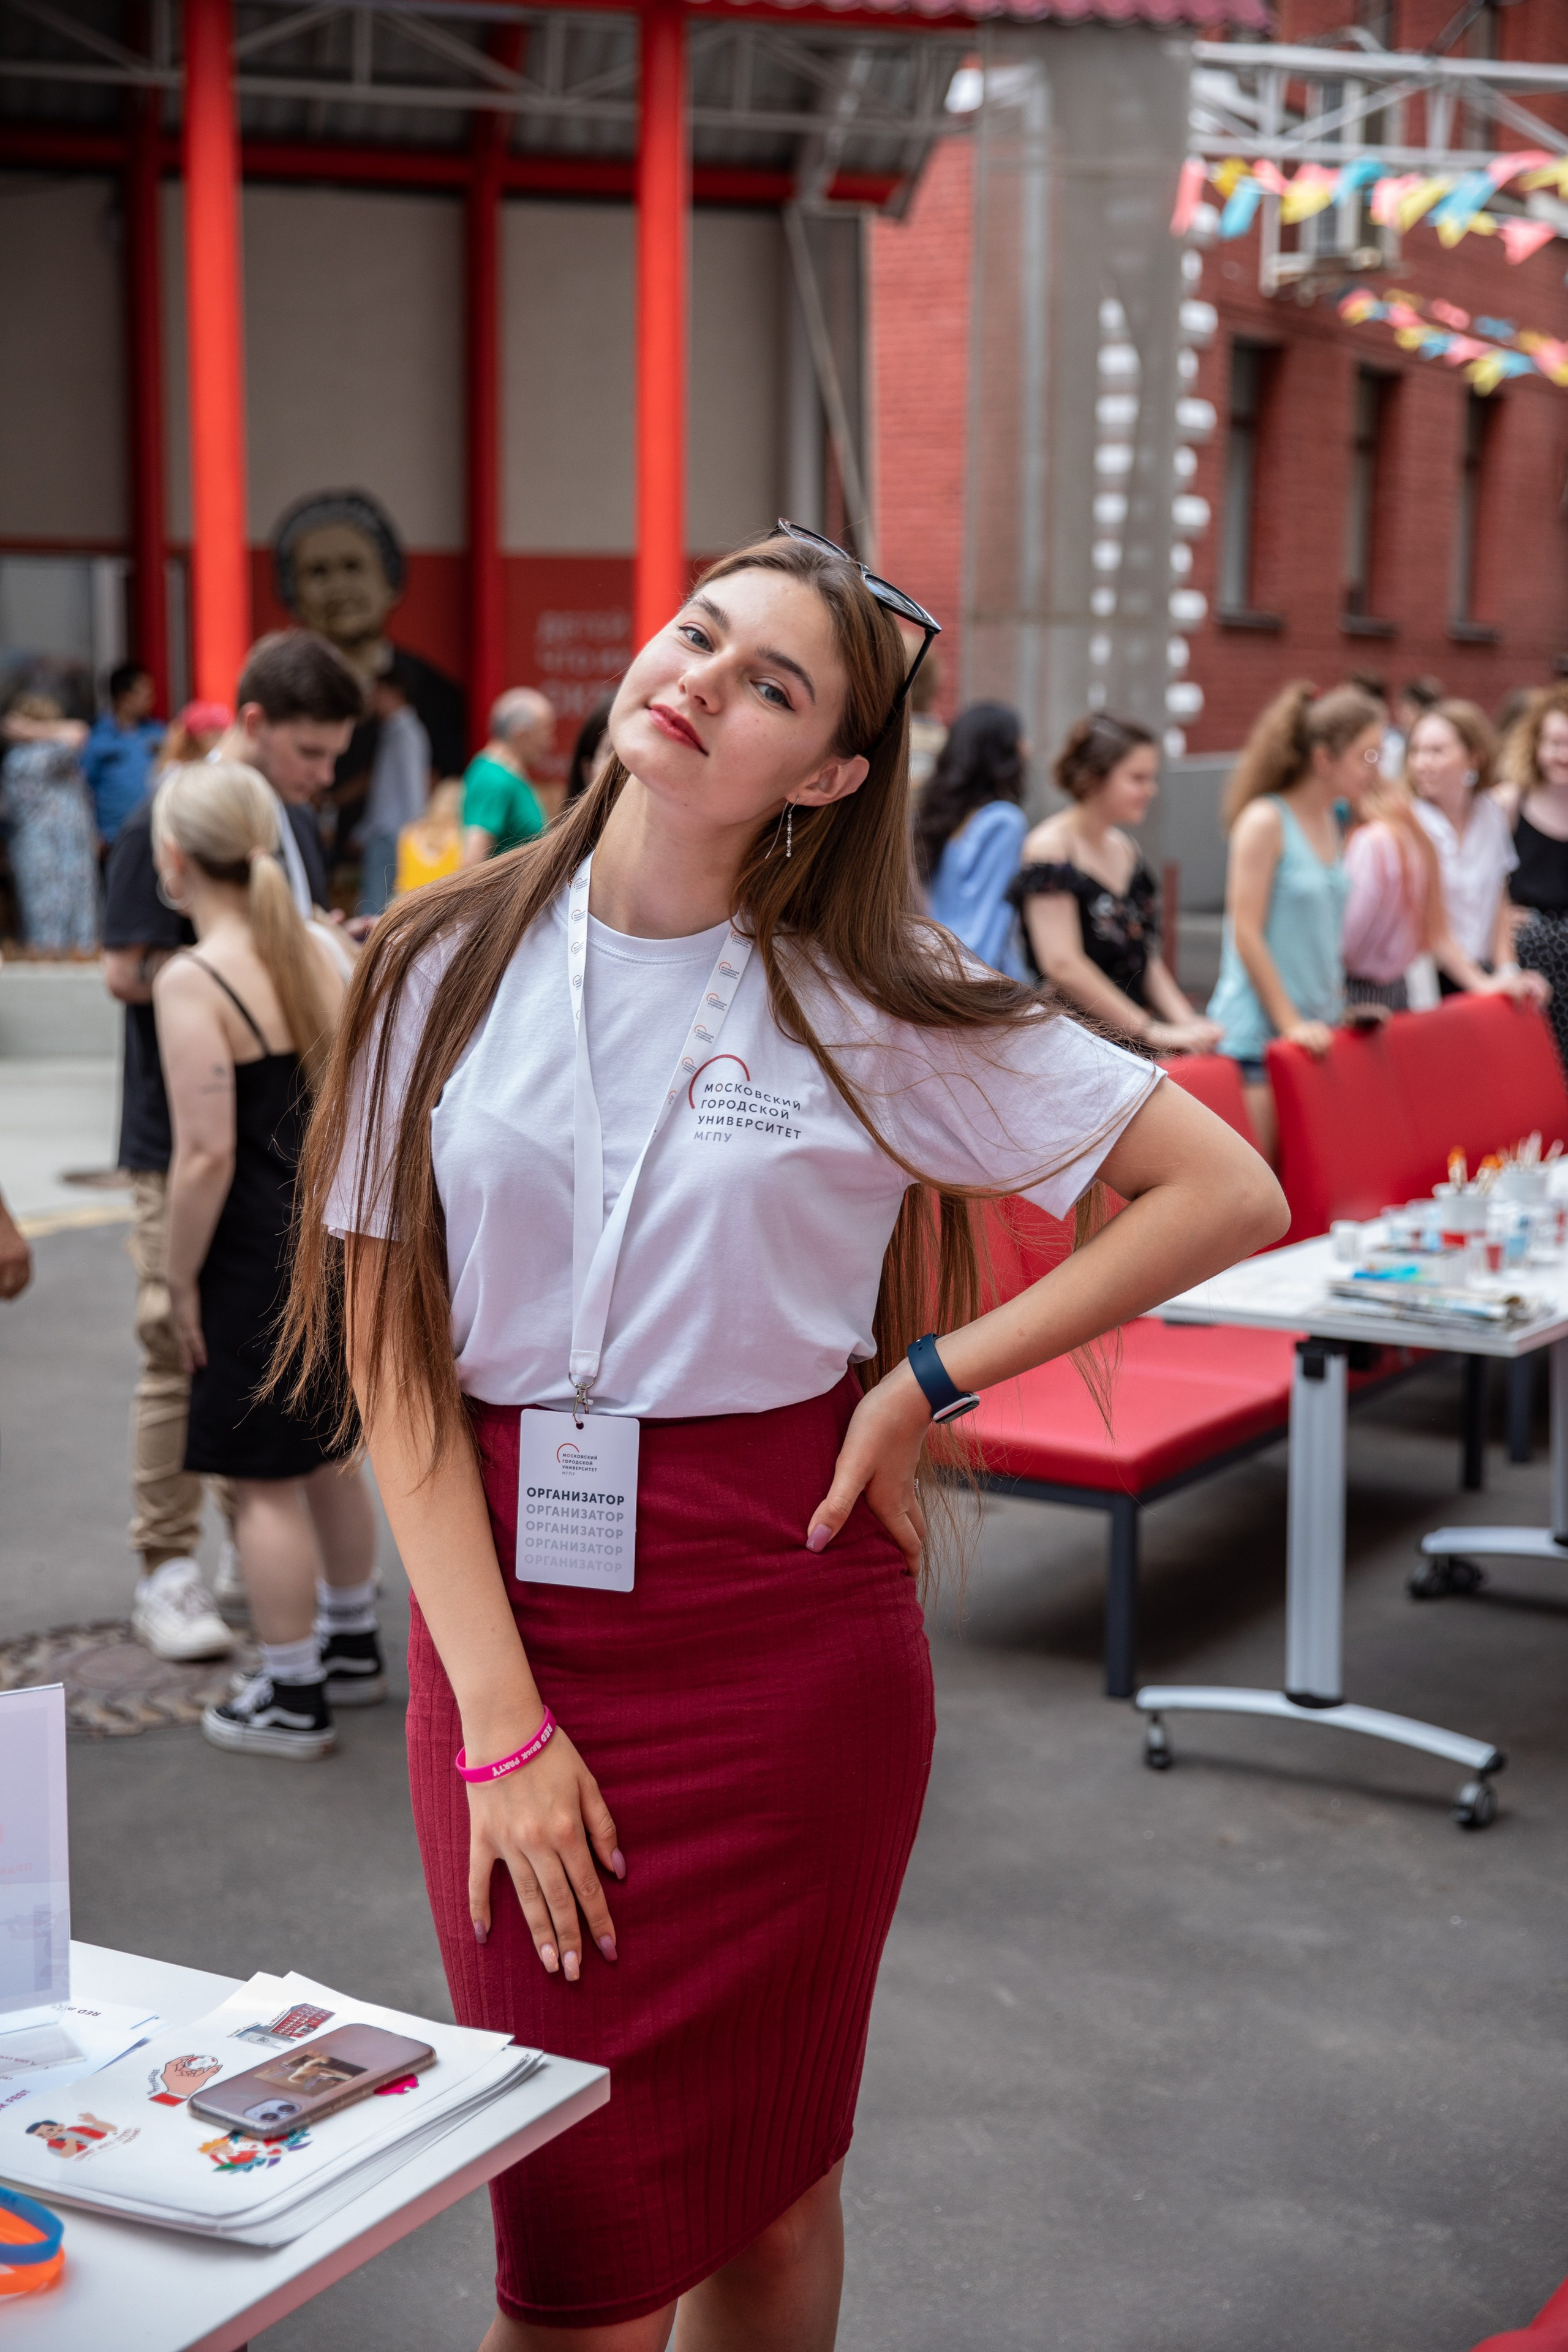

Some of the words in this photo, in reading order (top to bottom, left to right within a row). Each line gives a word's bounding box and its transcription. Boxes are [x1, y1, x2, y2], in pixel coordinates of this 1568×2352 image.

[704, 1083, 801, 1111] МОСКОВСКИЙ
[701, 1099, 789, 1120] ГОРОДСКОЙ
[694, 1131, 732, 1142] МГПУ
[698, 1115, 801, 1139] УНИВЕРСИТЕТ
[527, 1487, 625, 1506] ОРГАНИЗАТОР
[526, 1504, 624, 1522] ОРГАНИЗАТОР
[526, 1521, 624, 1539] ОРГАНИЗАТОР
[525, 1537, 623, 1556] ОРГАНИЗАТОР
[524, 1554, 622, 1572] ОРГАНИЗАТОР
[541, 1723, 552, 1742] RED
[492, 1757, 520, 1776] PARTY
[5, 2089, 31, 2103] FEST
